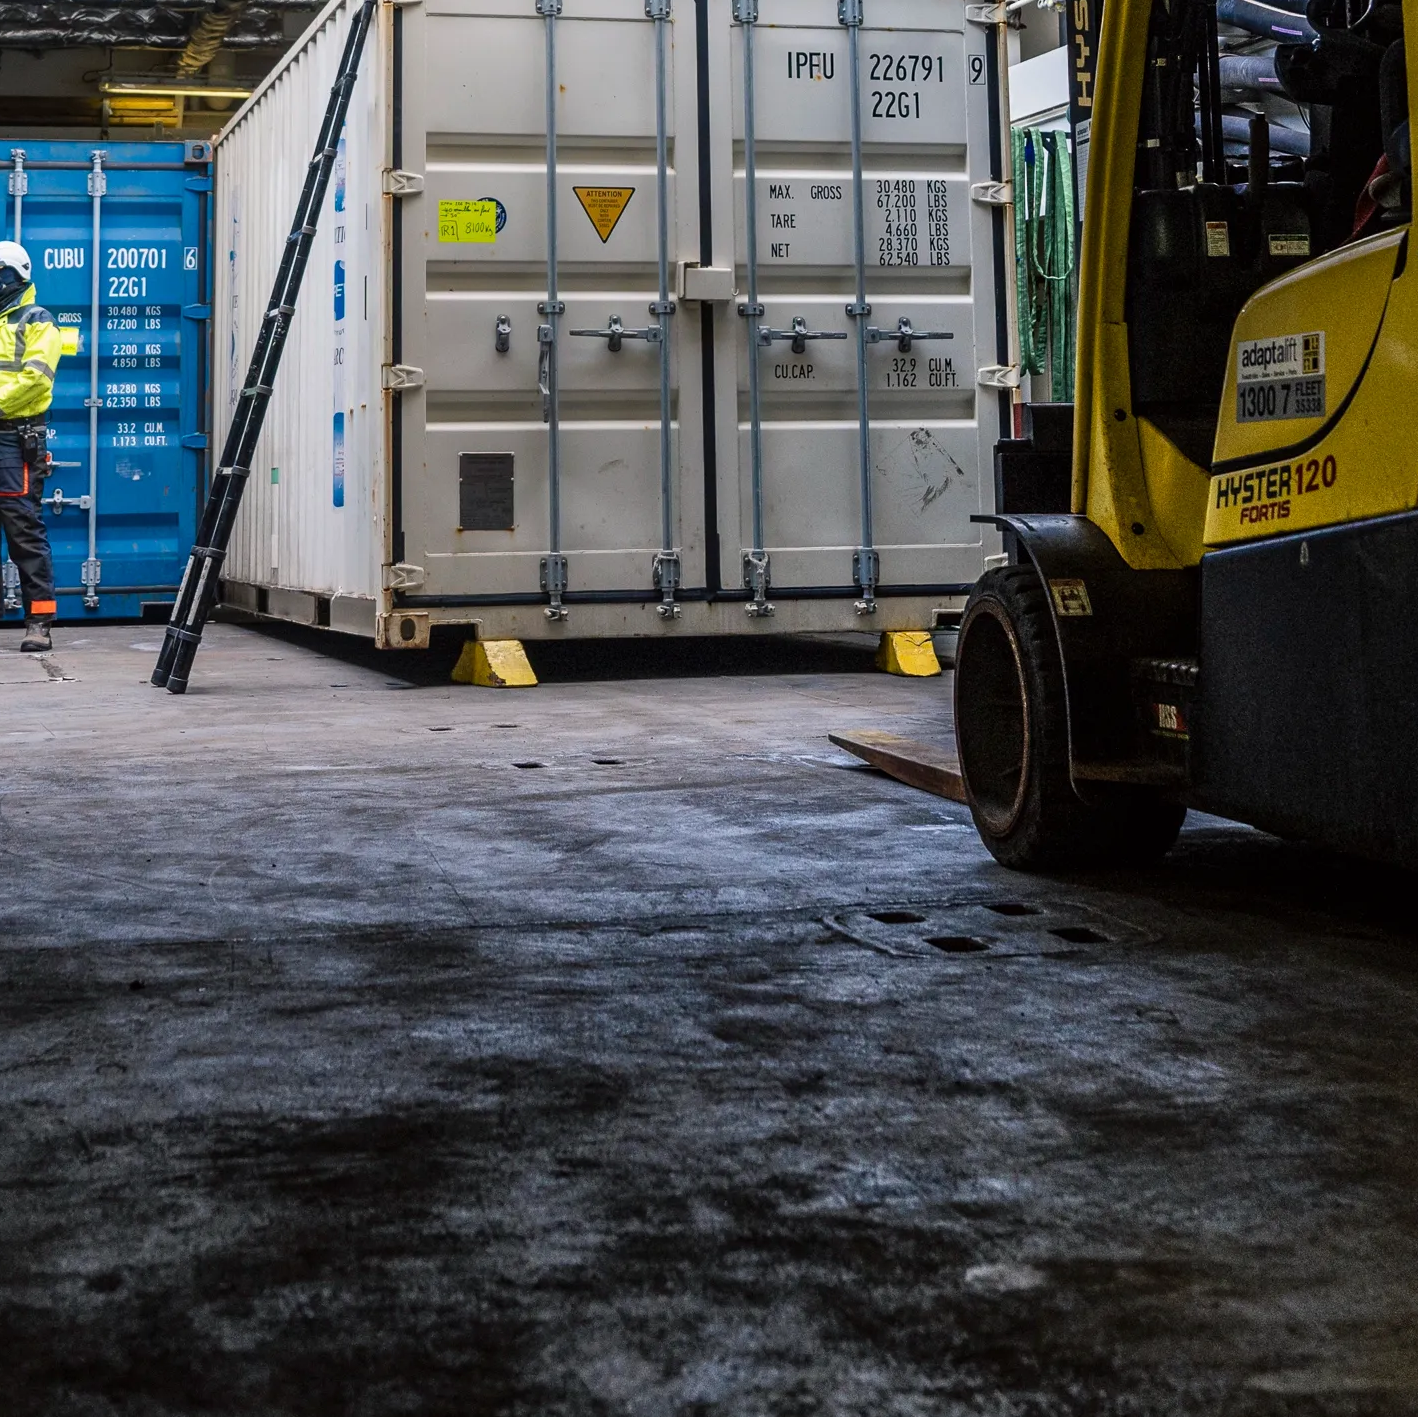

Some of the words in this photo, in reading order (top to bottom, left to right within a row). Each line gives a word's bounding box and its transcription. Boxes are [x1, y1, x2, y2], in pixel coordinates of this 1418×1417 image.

[788, 52, 834, 79] IPFU
[869, 54, 943, 82] 226791
[971, 56, 984, 84] 9
[872, 91, 920, 118] 22G1
[770, 185, 794, 200] MAX.
[811, 186, 842, 200] GROSS
[927, 180, 947, 193] KGS
[928, 195, 947, 208] LBS
[771, 214, 796, 228] TARE
[928, 209, 948, 222] KGS
[929, 224, 948, 236] LBS
[771, 244, 790, 258] NET
[929, 238, 949, 251] KGS
[44, 248, 84, 269] CUBU
[107, 248, 166, 269] 200701
[185, 248, 196, 269] 6
[931, 253, 950, 265] LBS
[109, 277, 147, 297] 22G1
[58, 313, 81, 323] GROSS
[107, 307, 137, 316] 30.480
[146, 306, 161, 316] KGS
[107, 319, 137, 330] 67.200
[145, 319, 161, 329] LBS
[113, 345, 137, 355] 2.200
[145, 344, 161, 354] KGS
[1242, 338, 1297, 370] adaptalift
[112, 358, 137, 368] 4.850
[145, 358, 161, 368] LBS
[775, 365, 815, 379] CU.CAP.
[893, 358, 916, 372] 32.9
[929, 358, 955, 372] CU.M.
[106, 384, 137, 394] 28.280
[145, 384, 161, 393] KGS
[929, 373, 959, 387] CU.FT.
[106, 397, 137, 407] 62.350
[145, 397, 161, 407] LBS
[1240, 386, 1276, 417] 1300
[1281, 384, 1291, 414] 7
[1295, 380, 1321, 396] FLEET
[117, 423, 136, 434] 33.2
[145, 423, 165, 433] CU.M.
[145, 436, 167, 446] CU.FT.
[1217, 464, 1291, 508] HYSTER
[1296, 455, 1337, 495] 120
[1240, 500, 1290, 525] FORTIS
